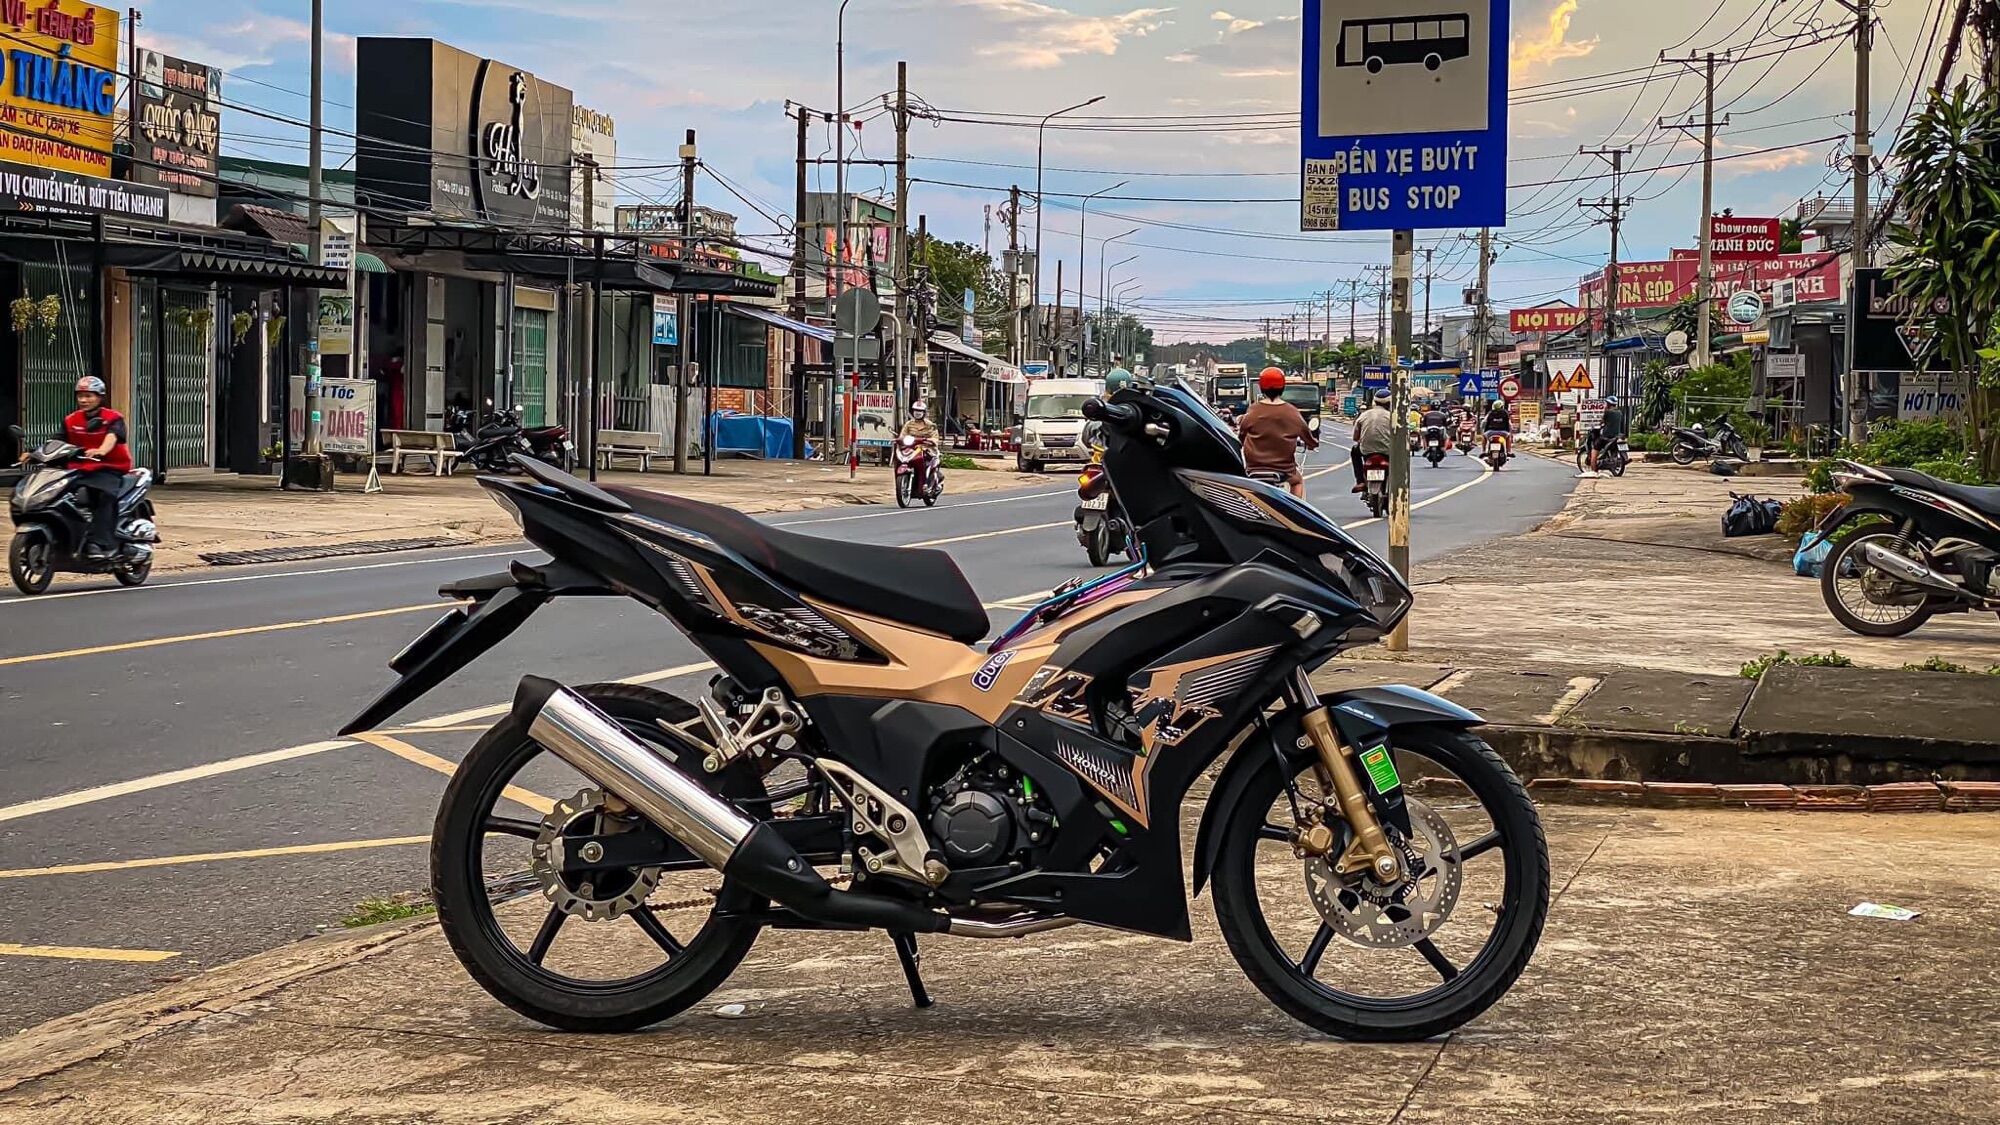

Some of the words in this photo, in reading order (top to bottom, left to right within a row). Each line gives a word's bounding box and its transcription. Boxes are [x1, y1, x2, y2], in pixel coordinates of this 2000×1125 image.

[1335, 139, 1377, 174] BẾN
[1421, 140, 1478, 172] BUÝT
[5, 173, 20, 200] VỤ
[22, 171, 63, 202] CHUYỂN
[89, 183, 108, 210] RÚT
[130, 193, 164, 217] NHANH
[1348, 187, 1390, 212] BUS
[1407, 184, 1461, 210] STOP
[1714, 222, 1768, 235] Showroom
[1746, 235, 1775, 252] ĐỨC
[1645, 275, 1675, 302] GÓP
[1517, 311, 1549, 331] NỘI
[1904, 387, 1936, 411] HỚT
[1072, 753, 1116, 784] HONDA
